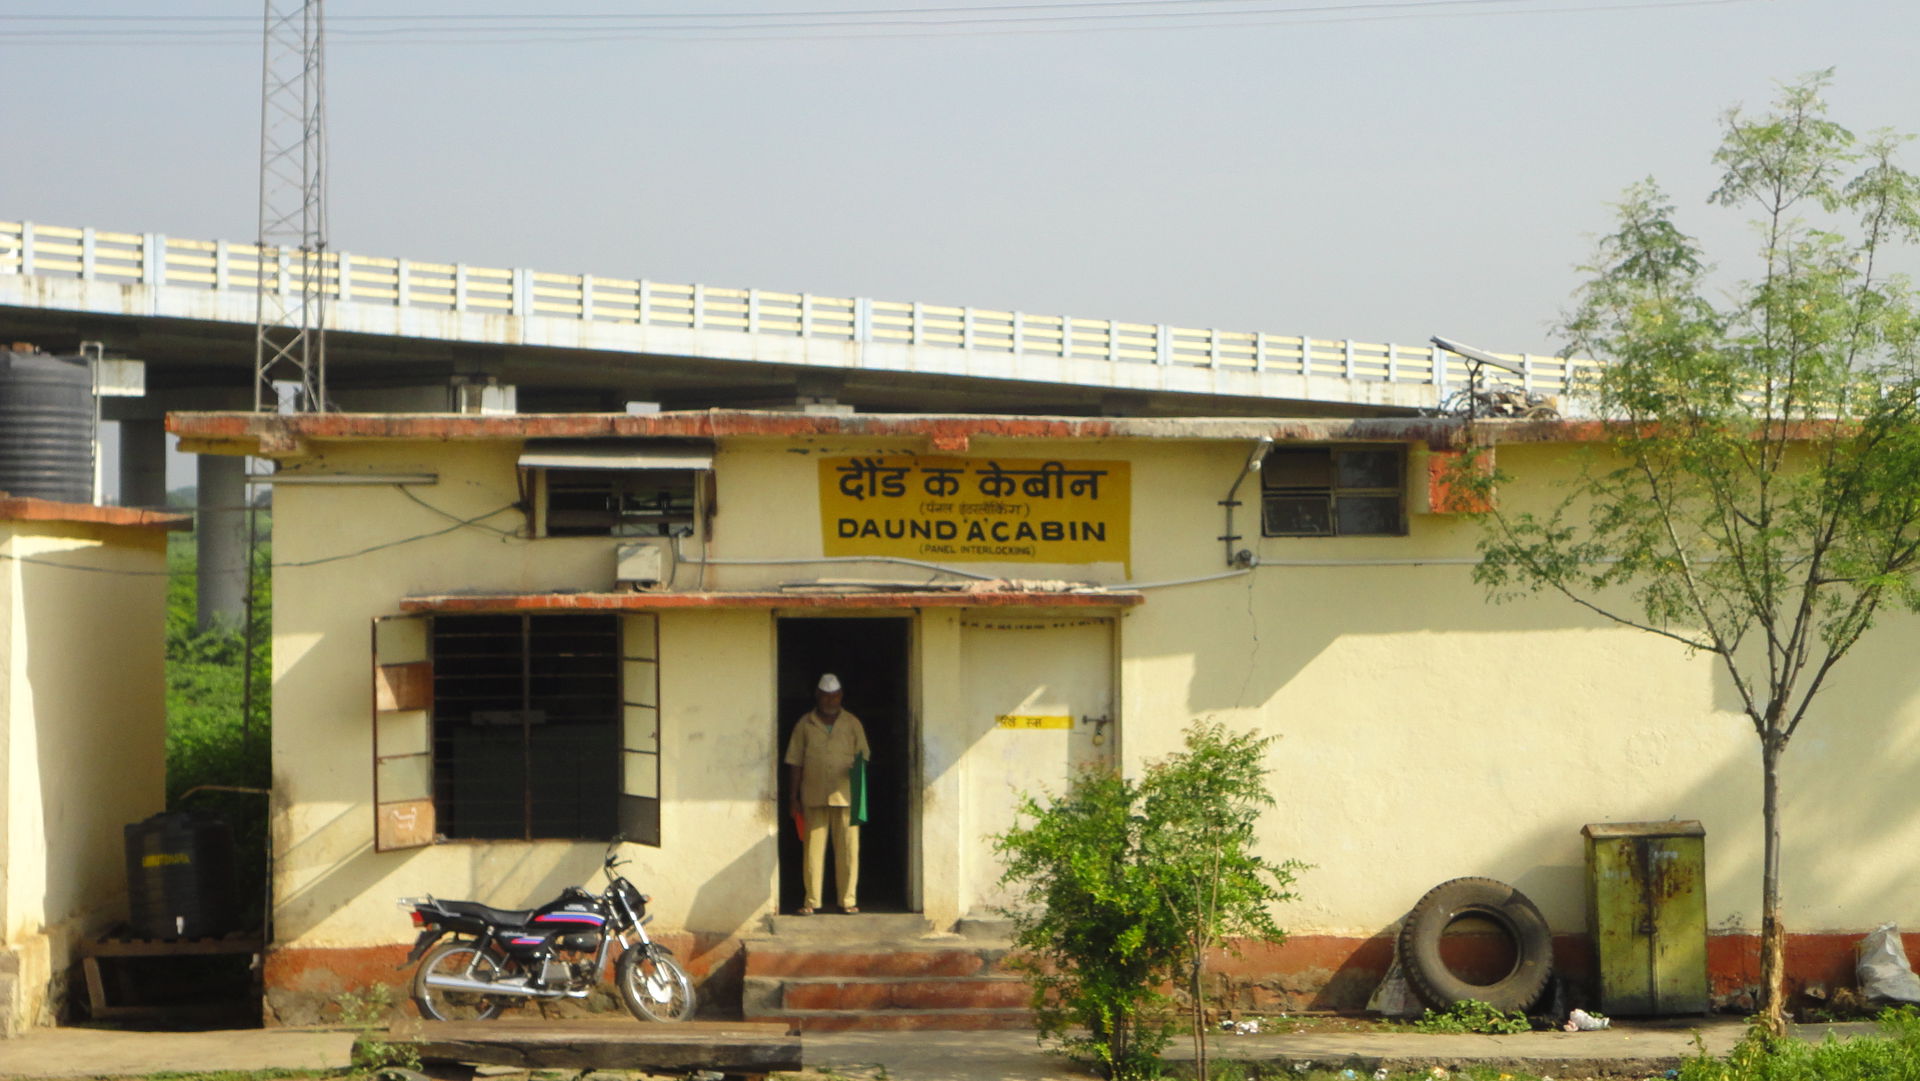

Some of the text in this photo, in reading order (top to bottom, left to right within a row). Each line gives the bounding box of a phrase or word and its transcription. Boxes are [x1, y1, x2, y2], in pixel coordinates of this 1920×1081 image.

[975, 461, 1109, 500] केबीन
[837, 518, 958, 541] DAUND
[991, 520, 1106, 543] CABIN
